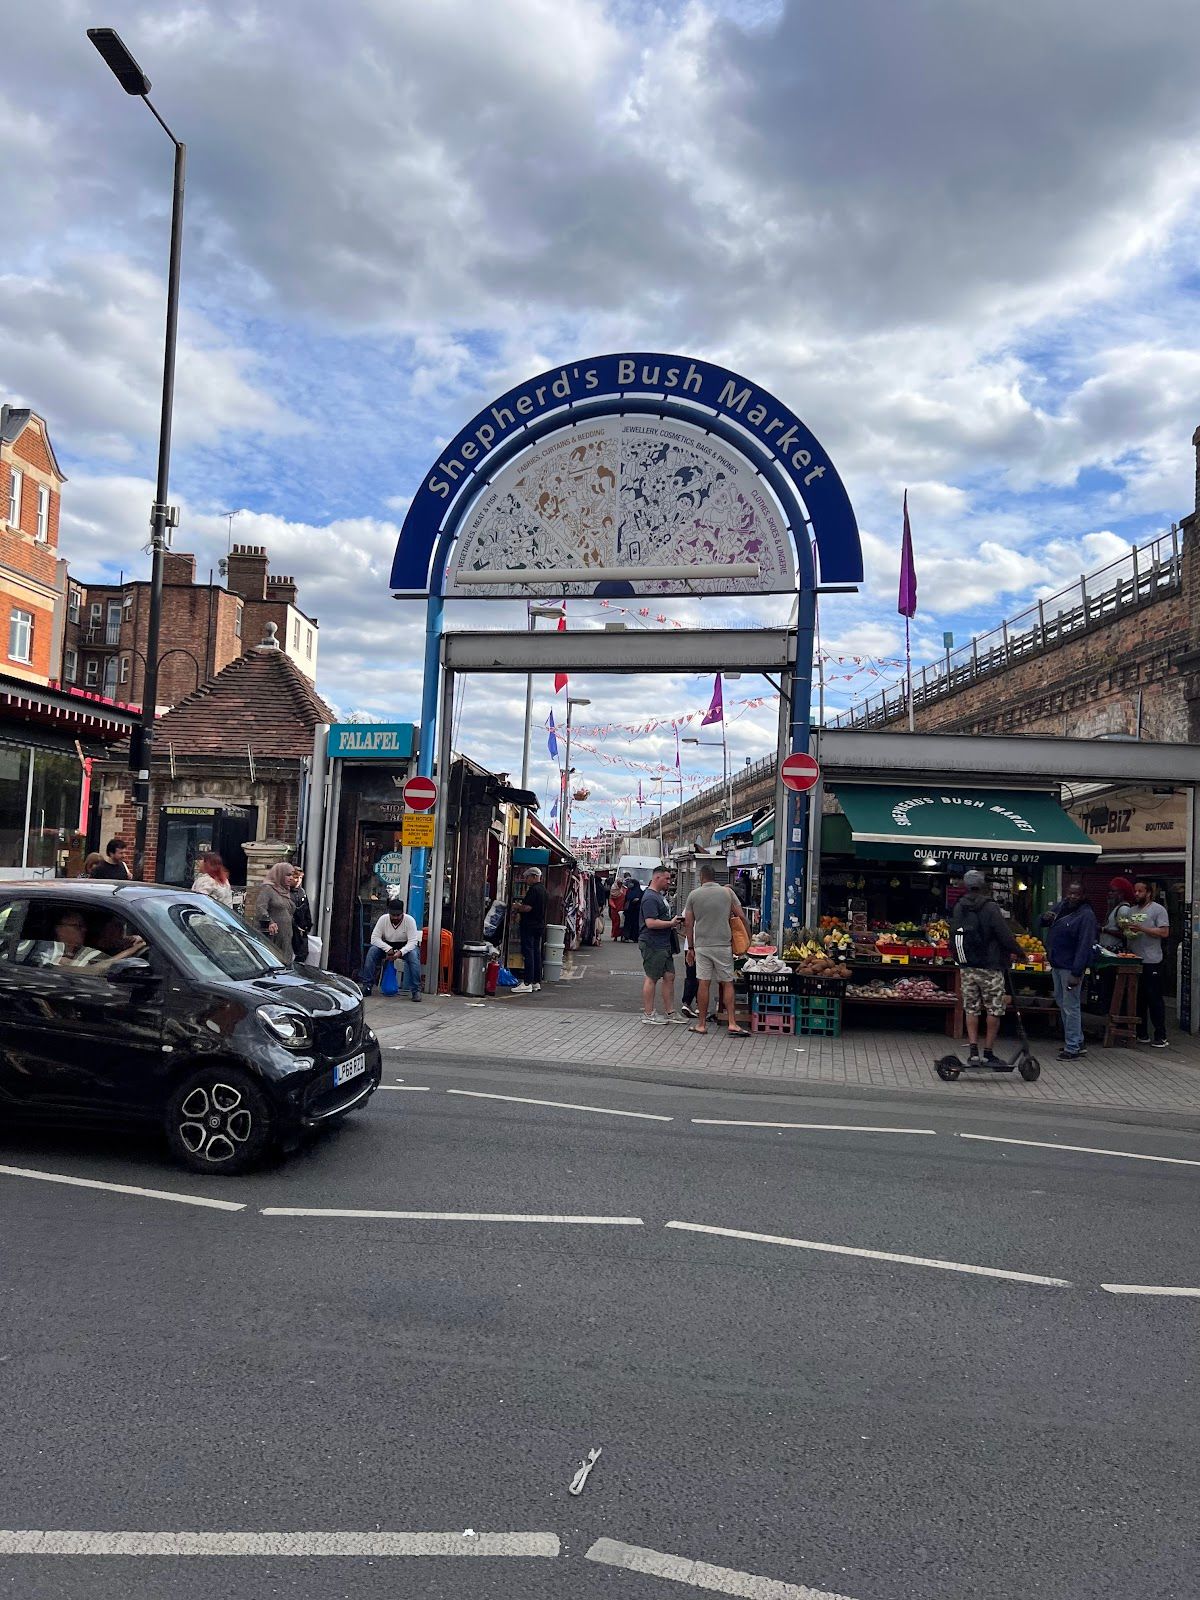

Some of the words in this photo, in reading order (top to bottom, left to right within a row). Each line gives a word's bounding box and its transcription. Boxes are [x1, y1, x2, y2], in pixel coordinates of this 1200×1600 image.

[428, 368, 599, 498] Shepherd's
[617, 360, 703, 393] Bush
[717, 379, 827, 486] Market
[541, 438, 571, 457] CURTAINS
[577, 428, 605, 440] BEDDING
[621, 426, 658, 435] JEWELLERY,
[659, 429, 695, 446] COSMETICS,
[695, 442, 713, 456] BAGS
[716, 454, 739, 475] PHONES
[472, 512, 485, 529] MEAT
[486, 493, 499, 510] FISH
[767, 517, 780, 540] SHOES
[776, 545, 788, 576] LINGERIE
[338, 731, 400, 750] FALAFEL
[172, 807, 209, 815] TELEPHONE
[891, 797, 935, 827] SHEPHERD'S
[940, 796, 985, 808] BUSH
[989, 805, 1036, 833] MARKET
[1145, 821, 1175, 832] BOUTIQUE
[913, 849, 952, 860] QUALITY
[953, 851, 980, 861] FRUIT
[981, 852, 988, 861] &
[990, 853, 1009, 862] VEG
[1011, 854, 1019, 863] @
[1021, 854, 1040, 863] W12
